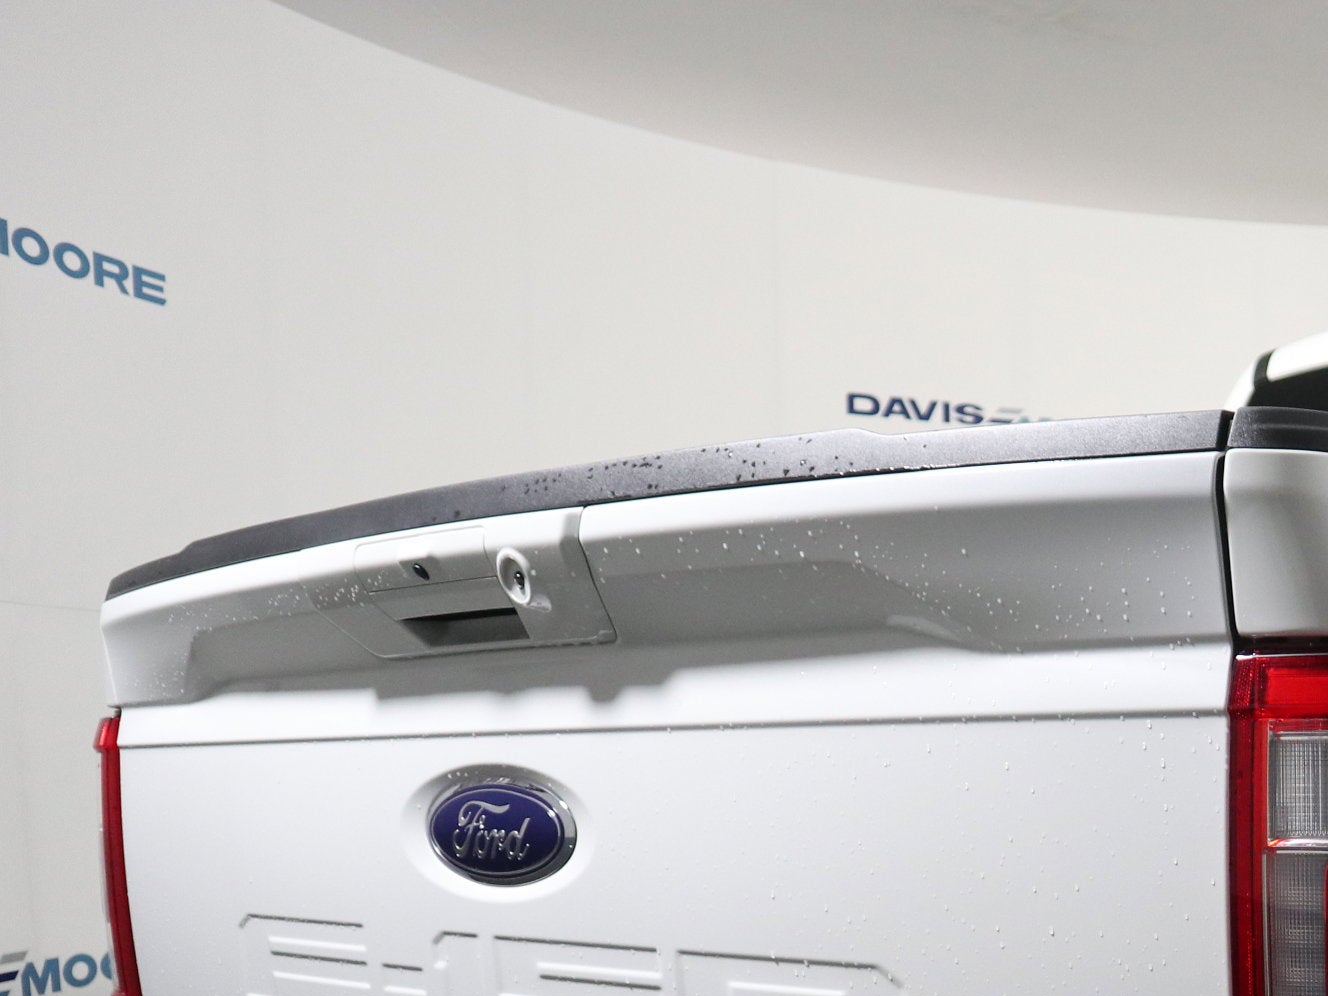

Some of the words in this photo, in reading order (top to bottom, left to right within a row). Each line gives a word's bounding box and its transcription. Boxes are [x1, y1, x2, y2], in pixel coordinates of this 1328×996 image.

[0, 217, 167, 306] OORE
[846, 392, 984, 425] DAVIS
[452, 800, 531, 860] Ford
